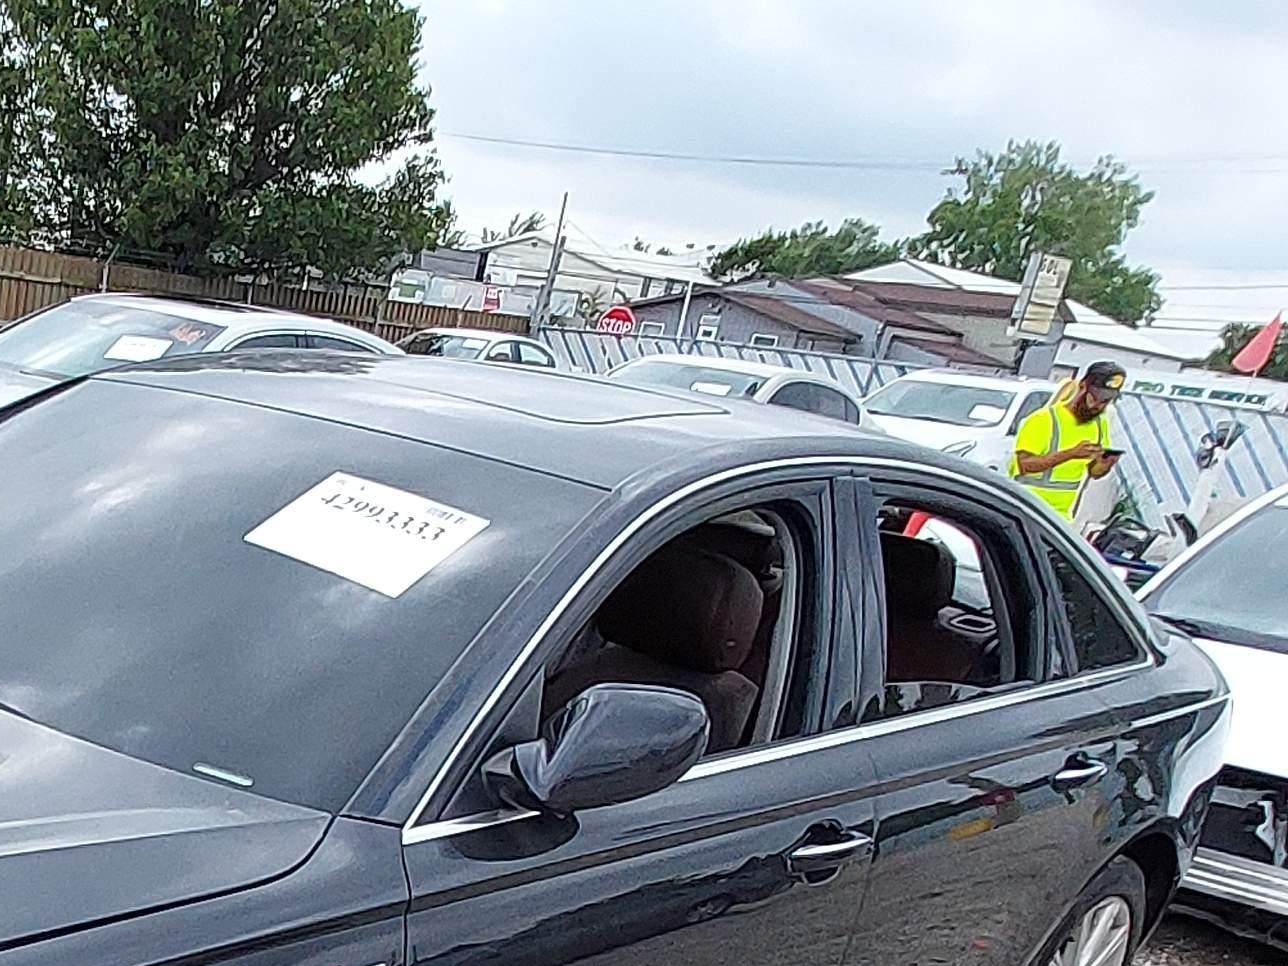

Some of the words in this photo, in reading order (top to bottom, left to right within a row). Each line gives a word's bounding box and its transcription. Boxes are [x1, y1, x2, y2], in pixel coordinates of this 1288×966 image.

[600, 317, 632, 334] STOP
[1132, 380, 1165, 394] PRO
[320, 493, 446, 541] 42993333
